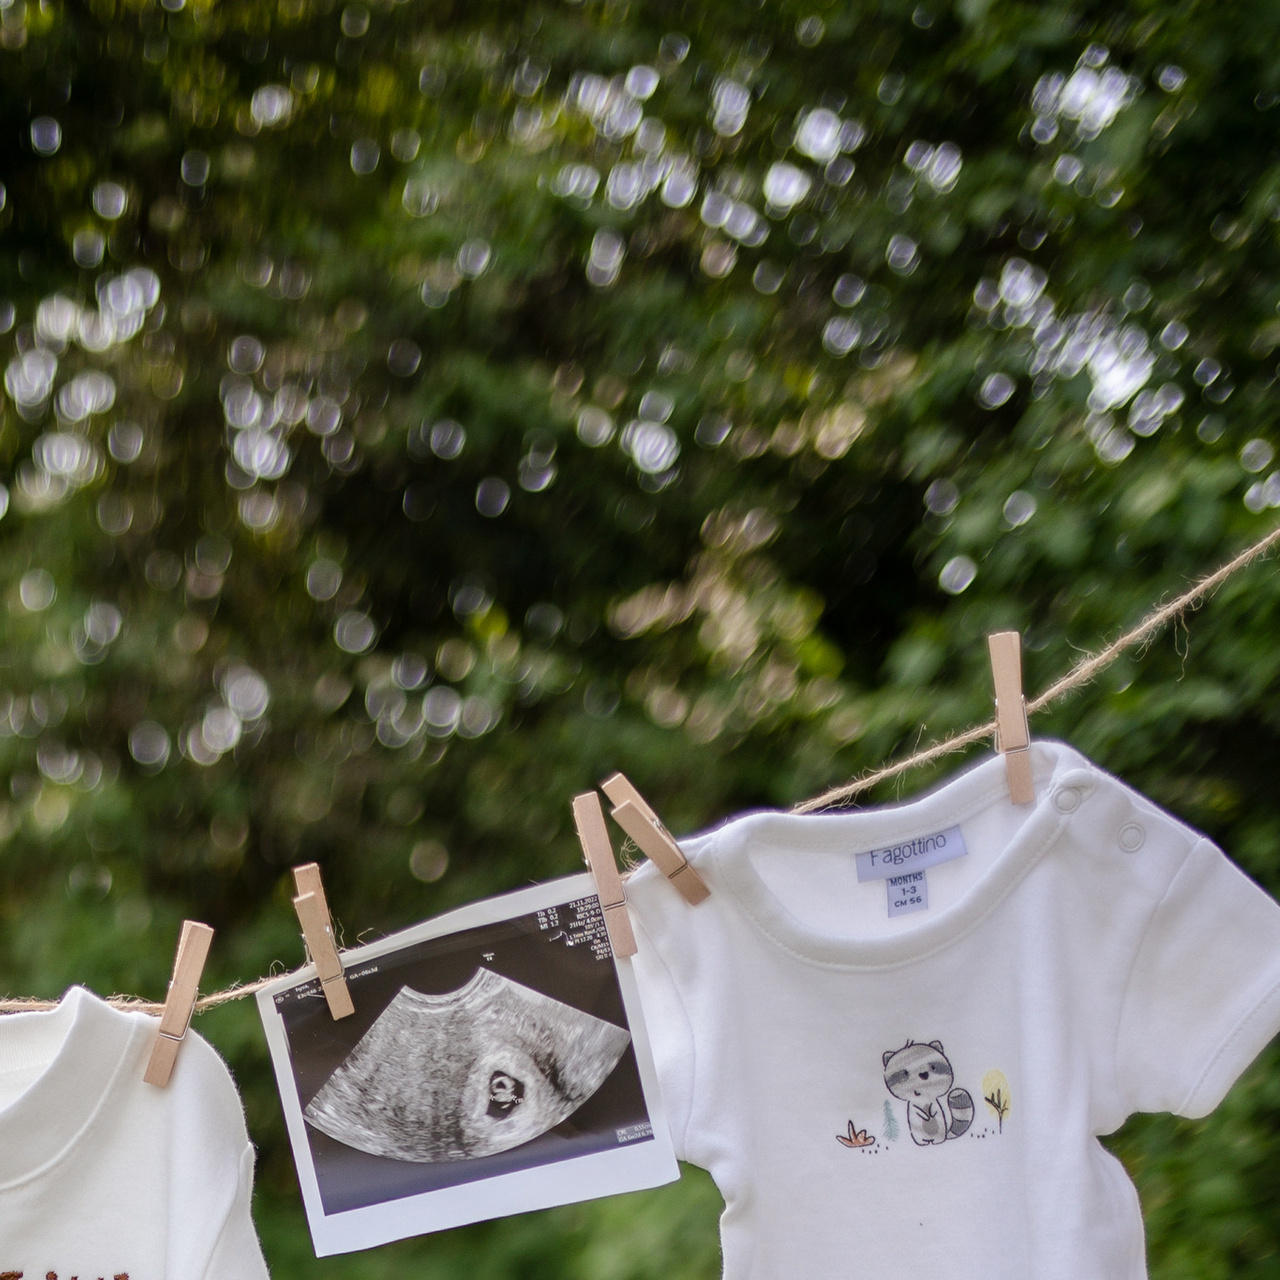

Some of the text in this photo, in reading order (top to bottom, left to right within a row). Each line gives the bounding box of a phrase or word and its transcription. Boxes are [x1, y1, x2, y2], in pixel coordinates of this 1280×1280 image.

[870, 834, 947, 867] Fagottino
[889, 872, 923, 887] MONTHS
[901, 886, 917, 896] 1-3
[894, 896, 922, 908] CM 56
